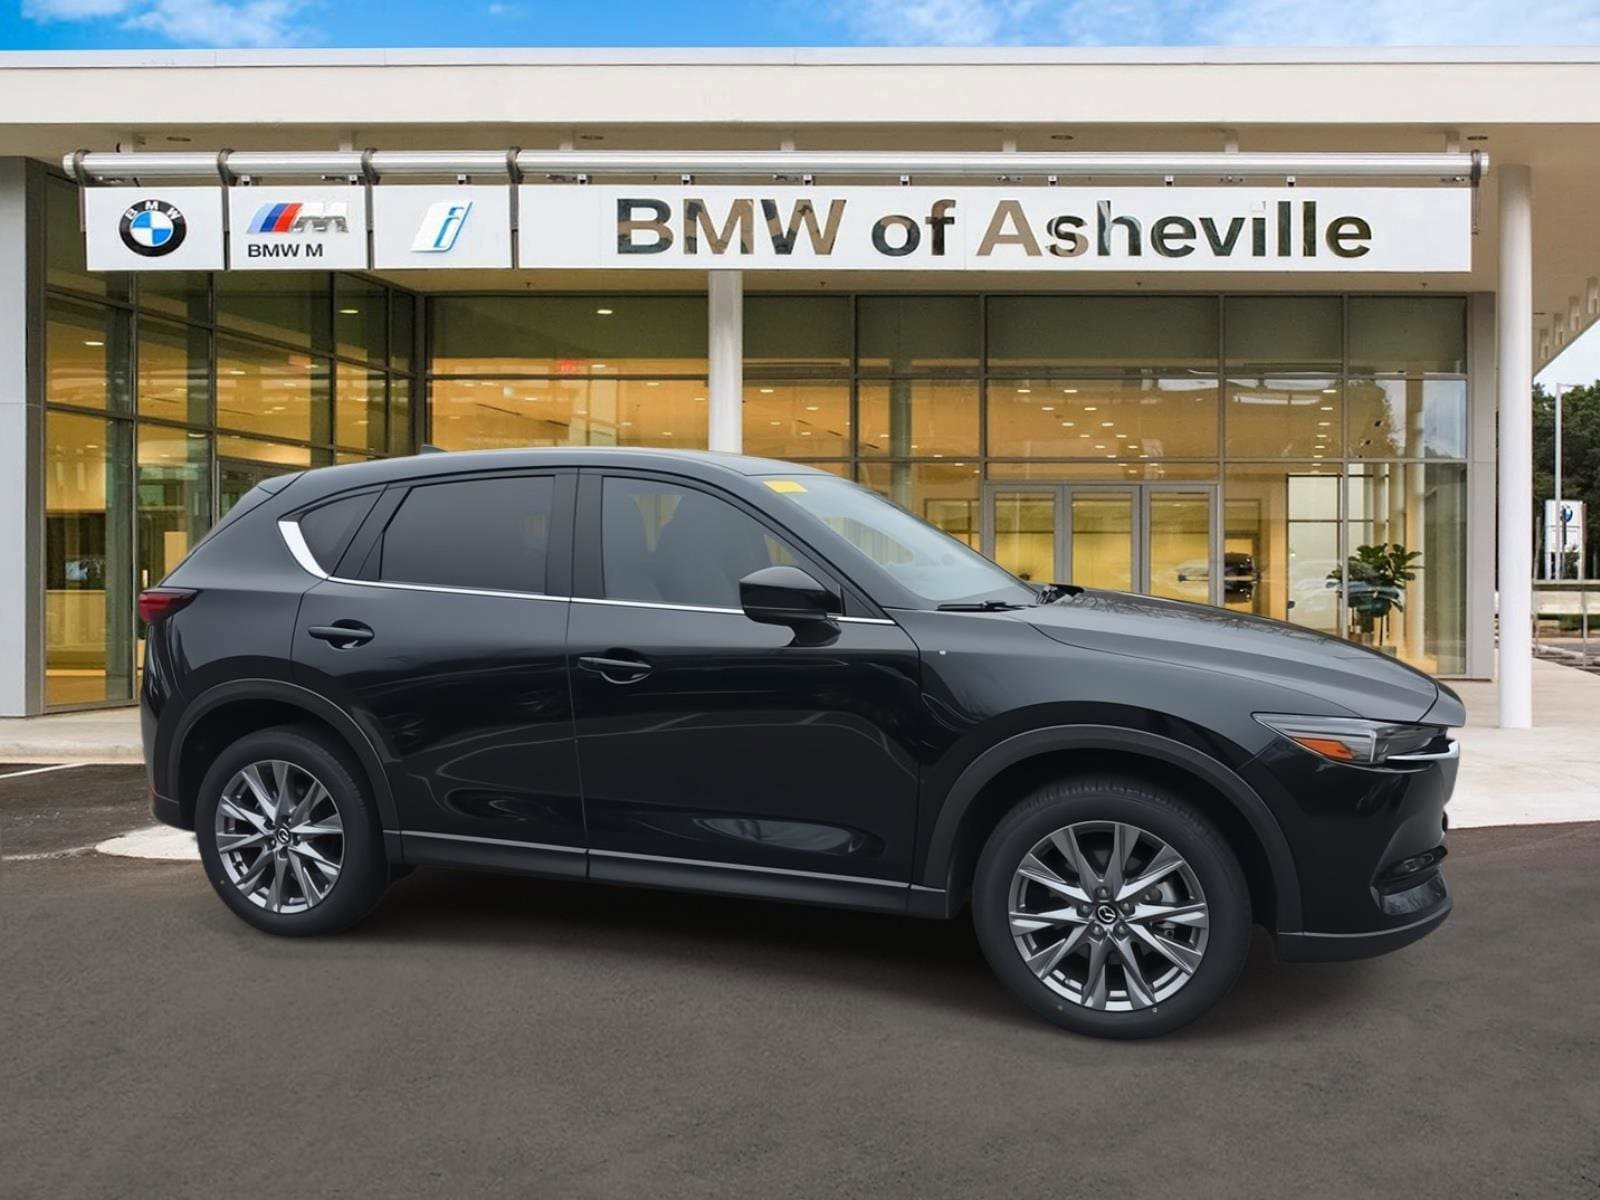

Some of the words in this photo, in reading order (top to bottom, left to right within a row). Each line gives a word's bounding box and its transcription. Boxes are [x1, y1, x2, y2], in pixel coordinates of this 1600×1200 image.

[125, 200, 181, 220] BMW
[616, 198, 847, 256] BMW
[871, 199, 956, 257] of
[976, 199, 1372, 258] Asheville
[247, 243, 300, 258] BMW
[305, 243, 324, 258] M
